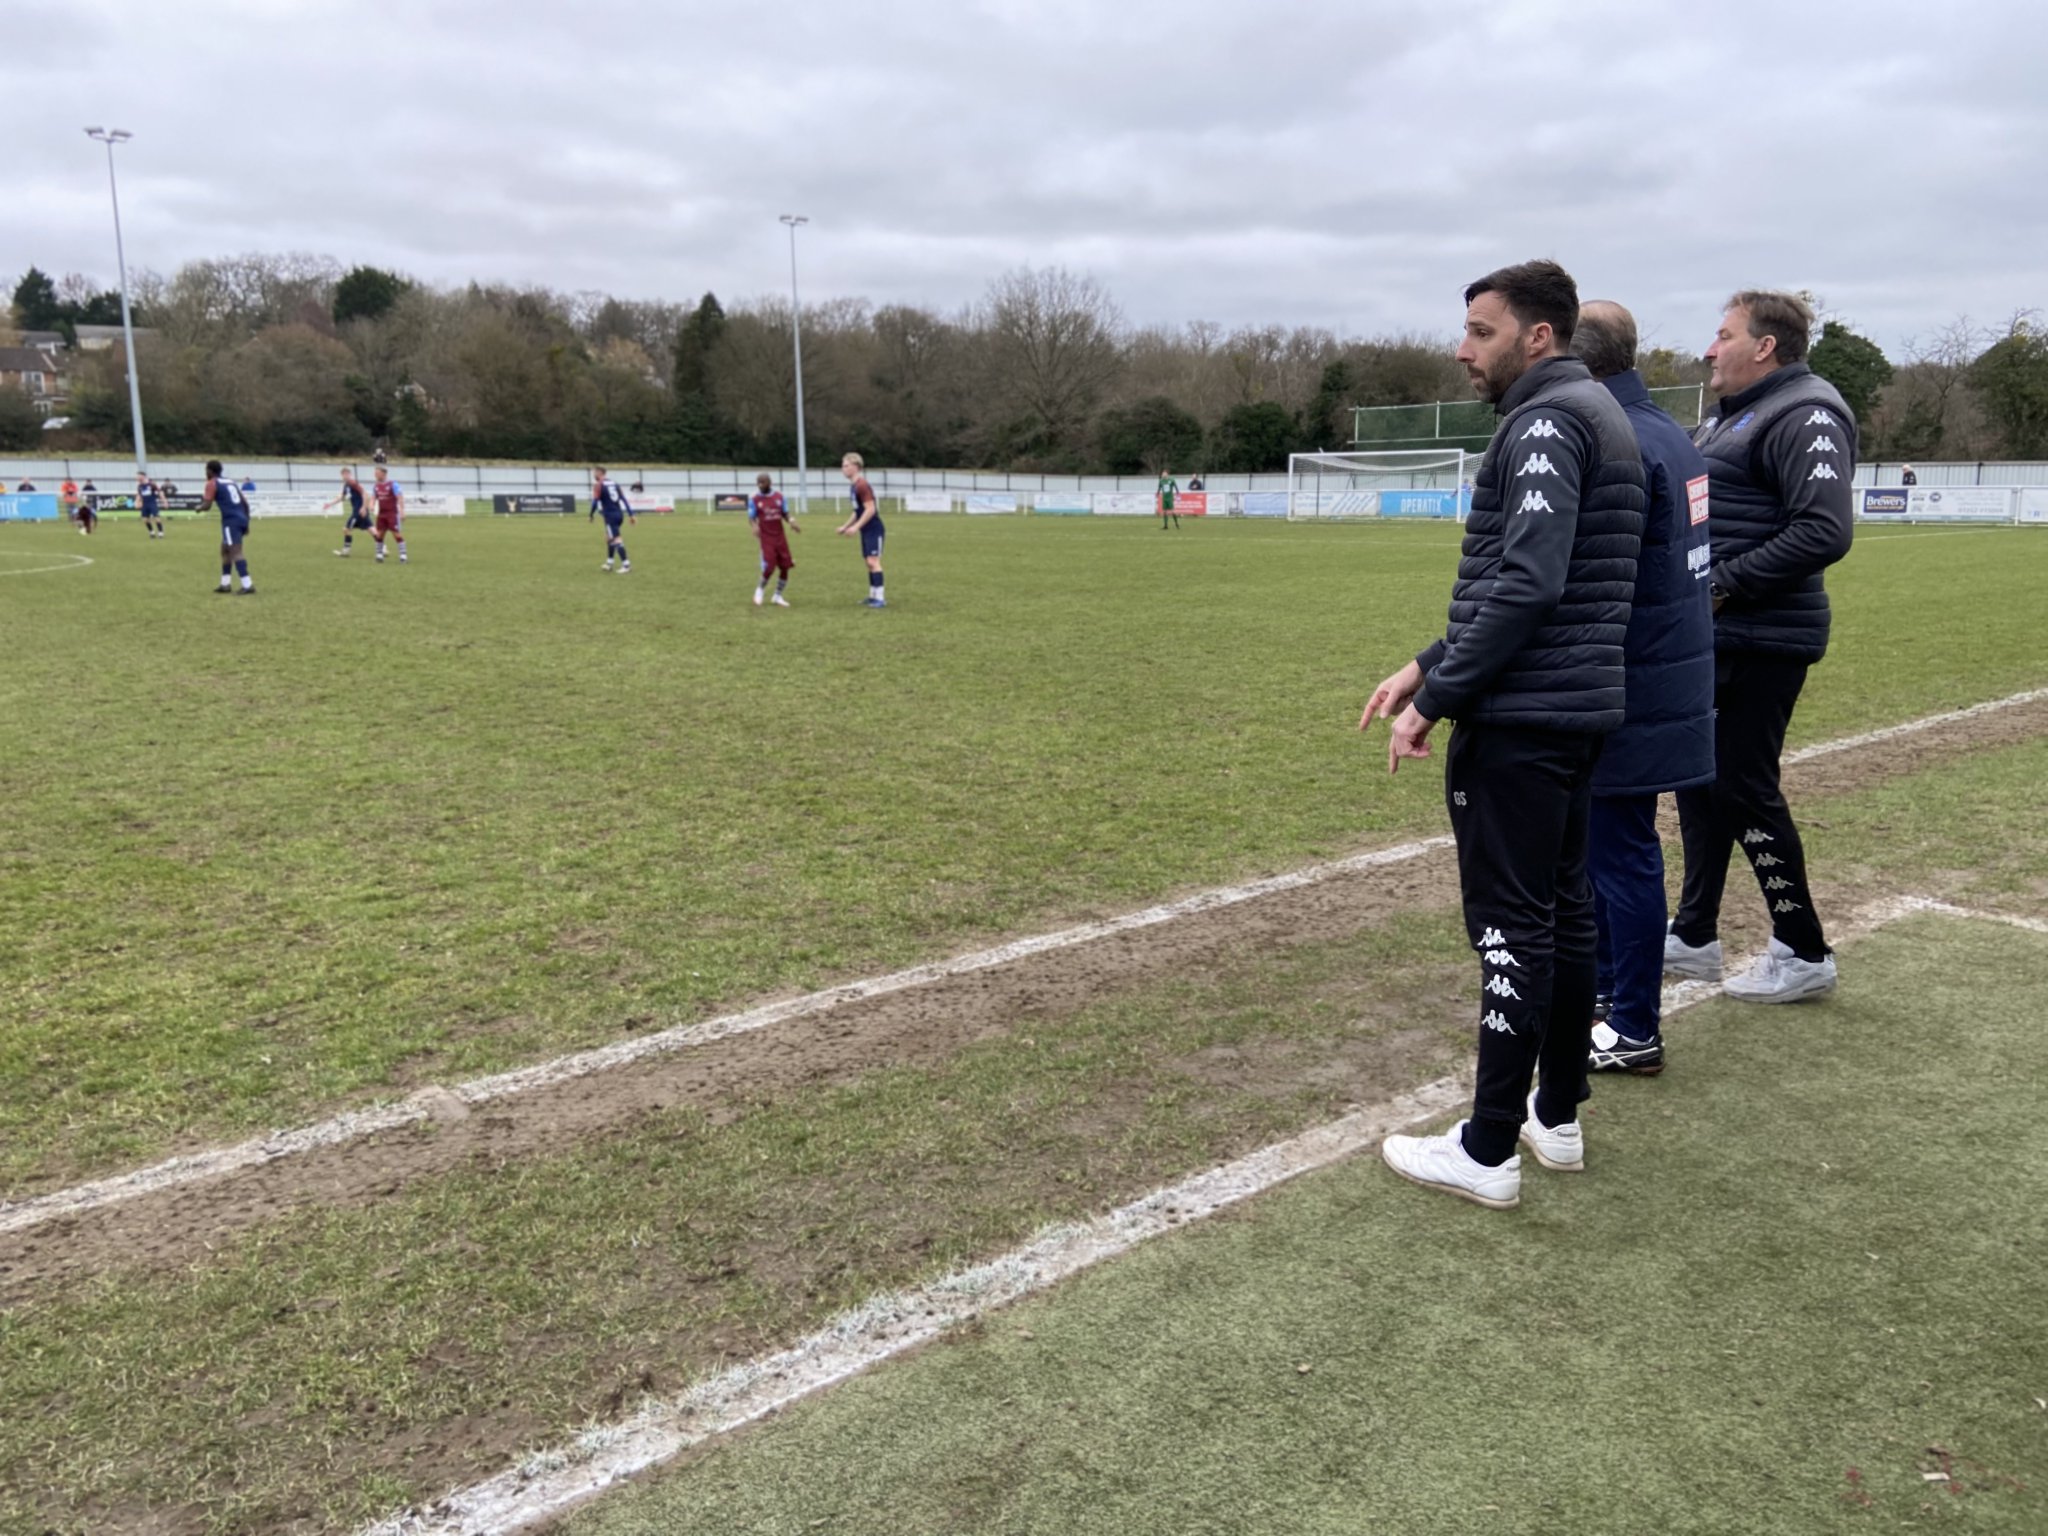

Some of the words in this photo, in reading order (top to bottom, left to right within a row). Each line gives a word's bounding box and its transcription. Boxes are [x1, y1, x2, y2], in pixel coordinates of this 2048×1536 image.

[1400, 499, 1441, 513] OPERATIX
[1866, 496, 1906, 506] Brewers
[1453, 791, 1467, 806] GS
